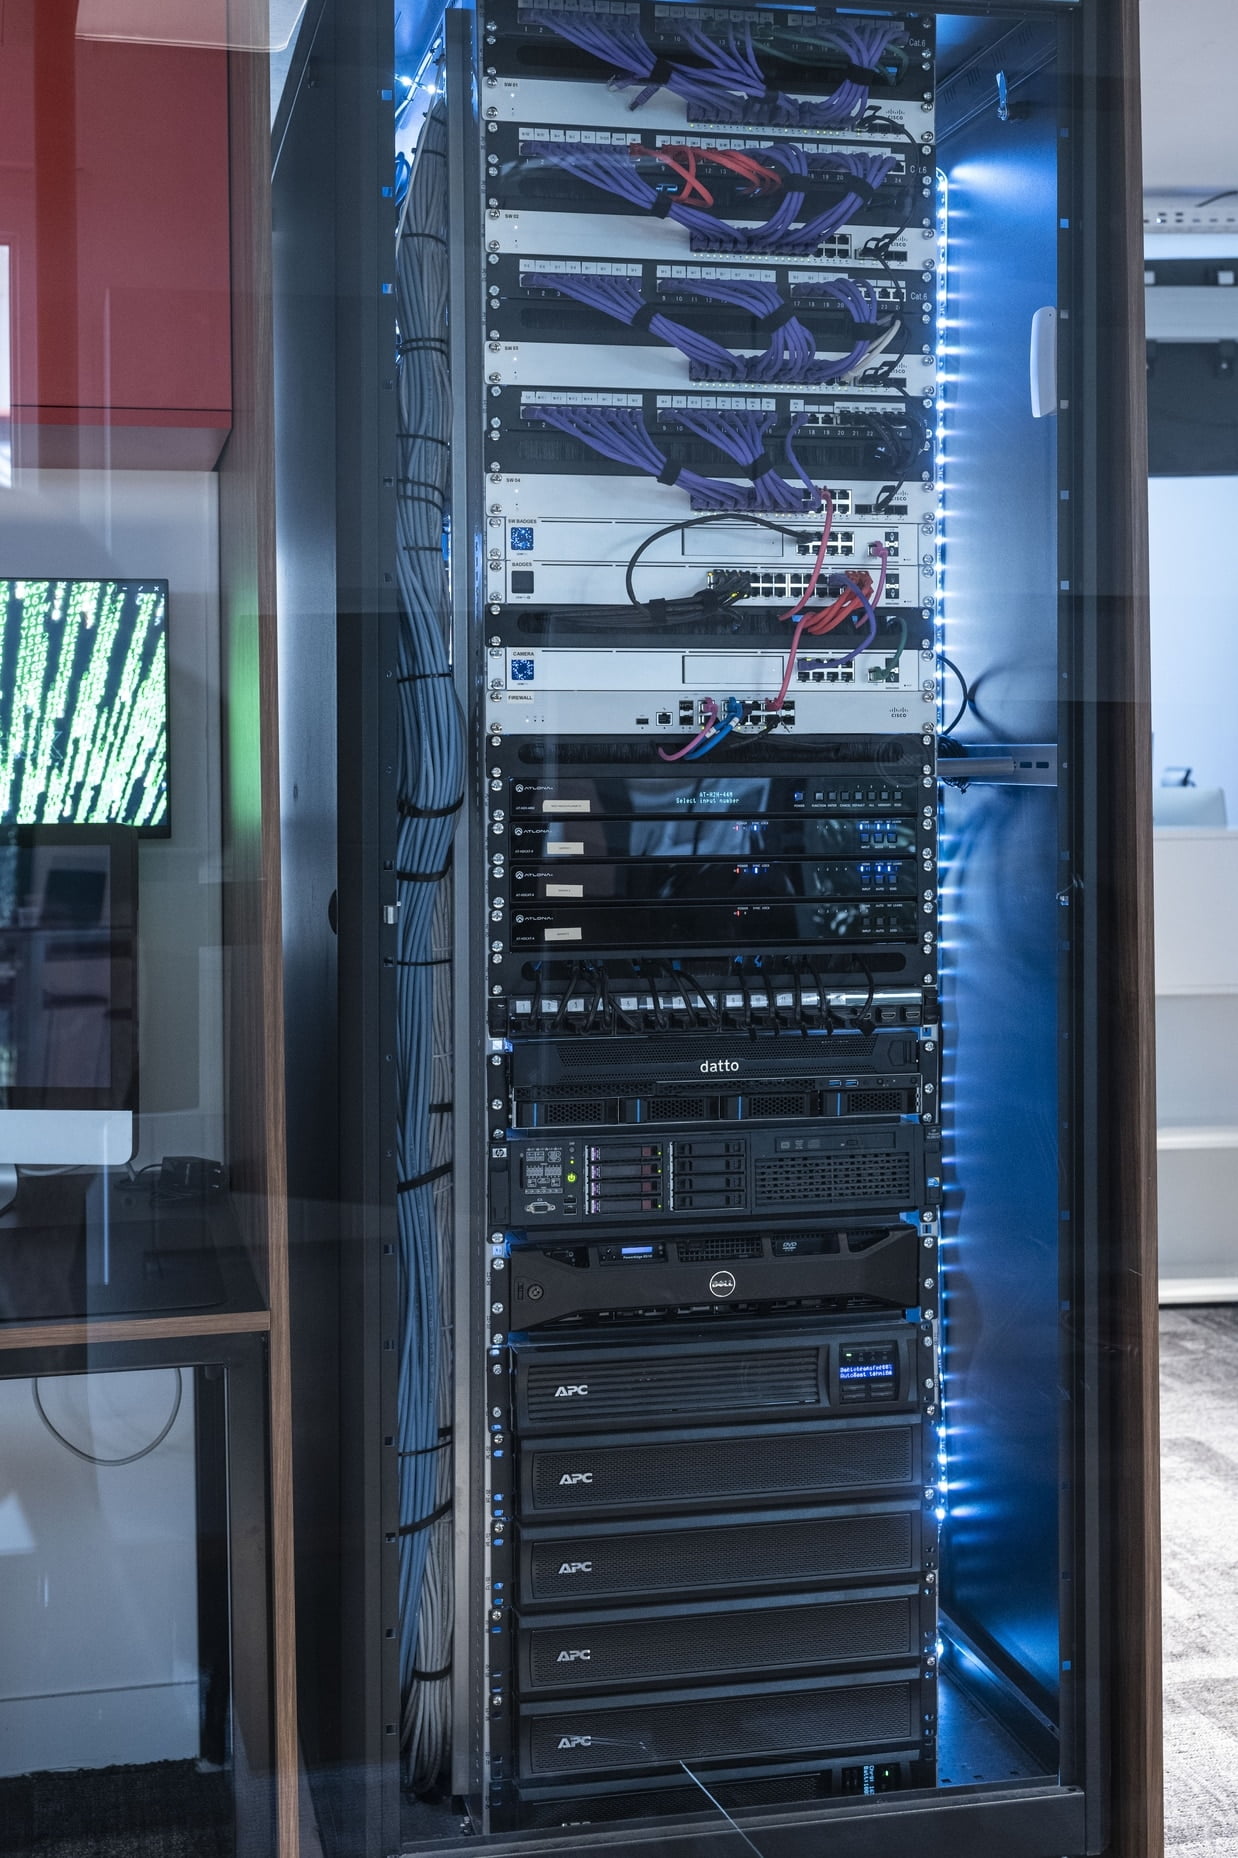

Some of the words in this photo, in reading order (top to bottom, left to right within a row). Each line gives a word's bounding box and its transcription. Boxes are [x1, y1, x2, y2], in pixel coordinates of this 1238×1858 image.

[908, 38, 926, 47] Cat.6
[909, 164, 927, 174] Ct.6
[910, 291, 928, 301] Cat.6
[700, 1059, 739, 1073] datto
[554, 1384, 588, 1397] APC
[559, 1472, 593, 1485] APC
[558, 1561, 592, 1574] APC
[556, 1649, 591, 1662] APC
[557, 1735, 592, 1749] APC
